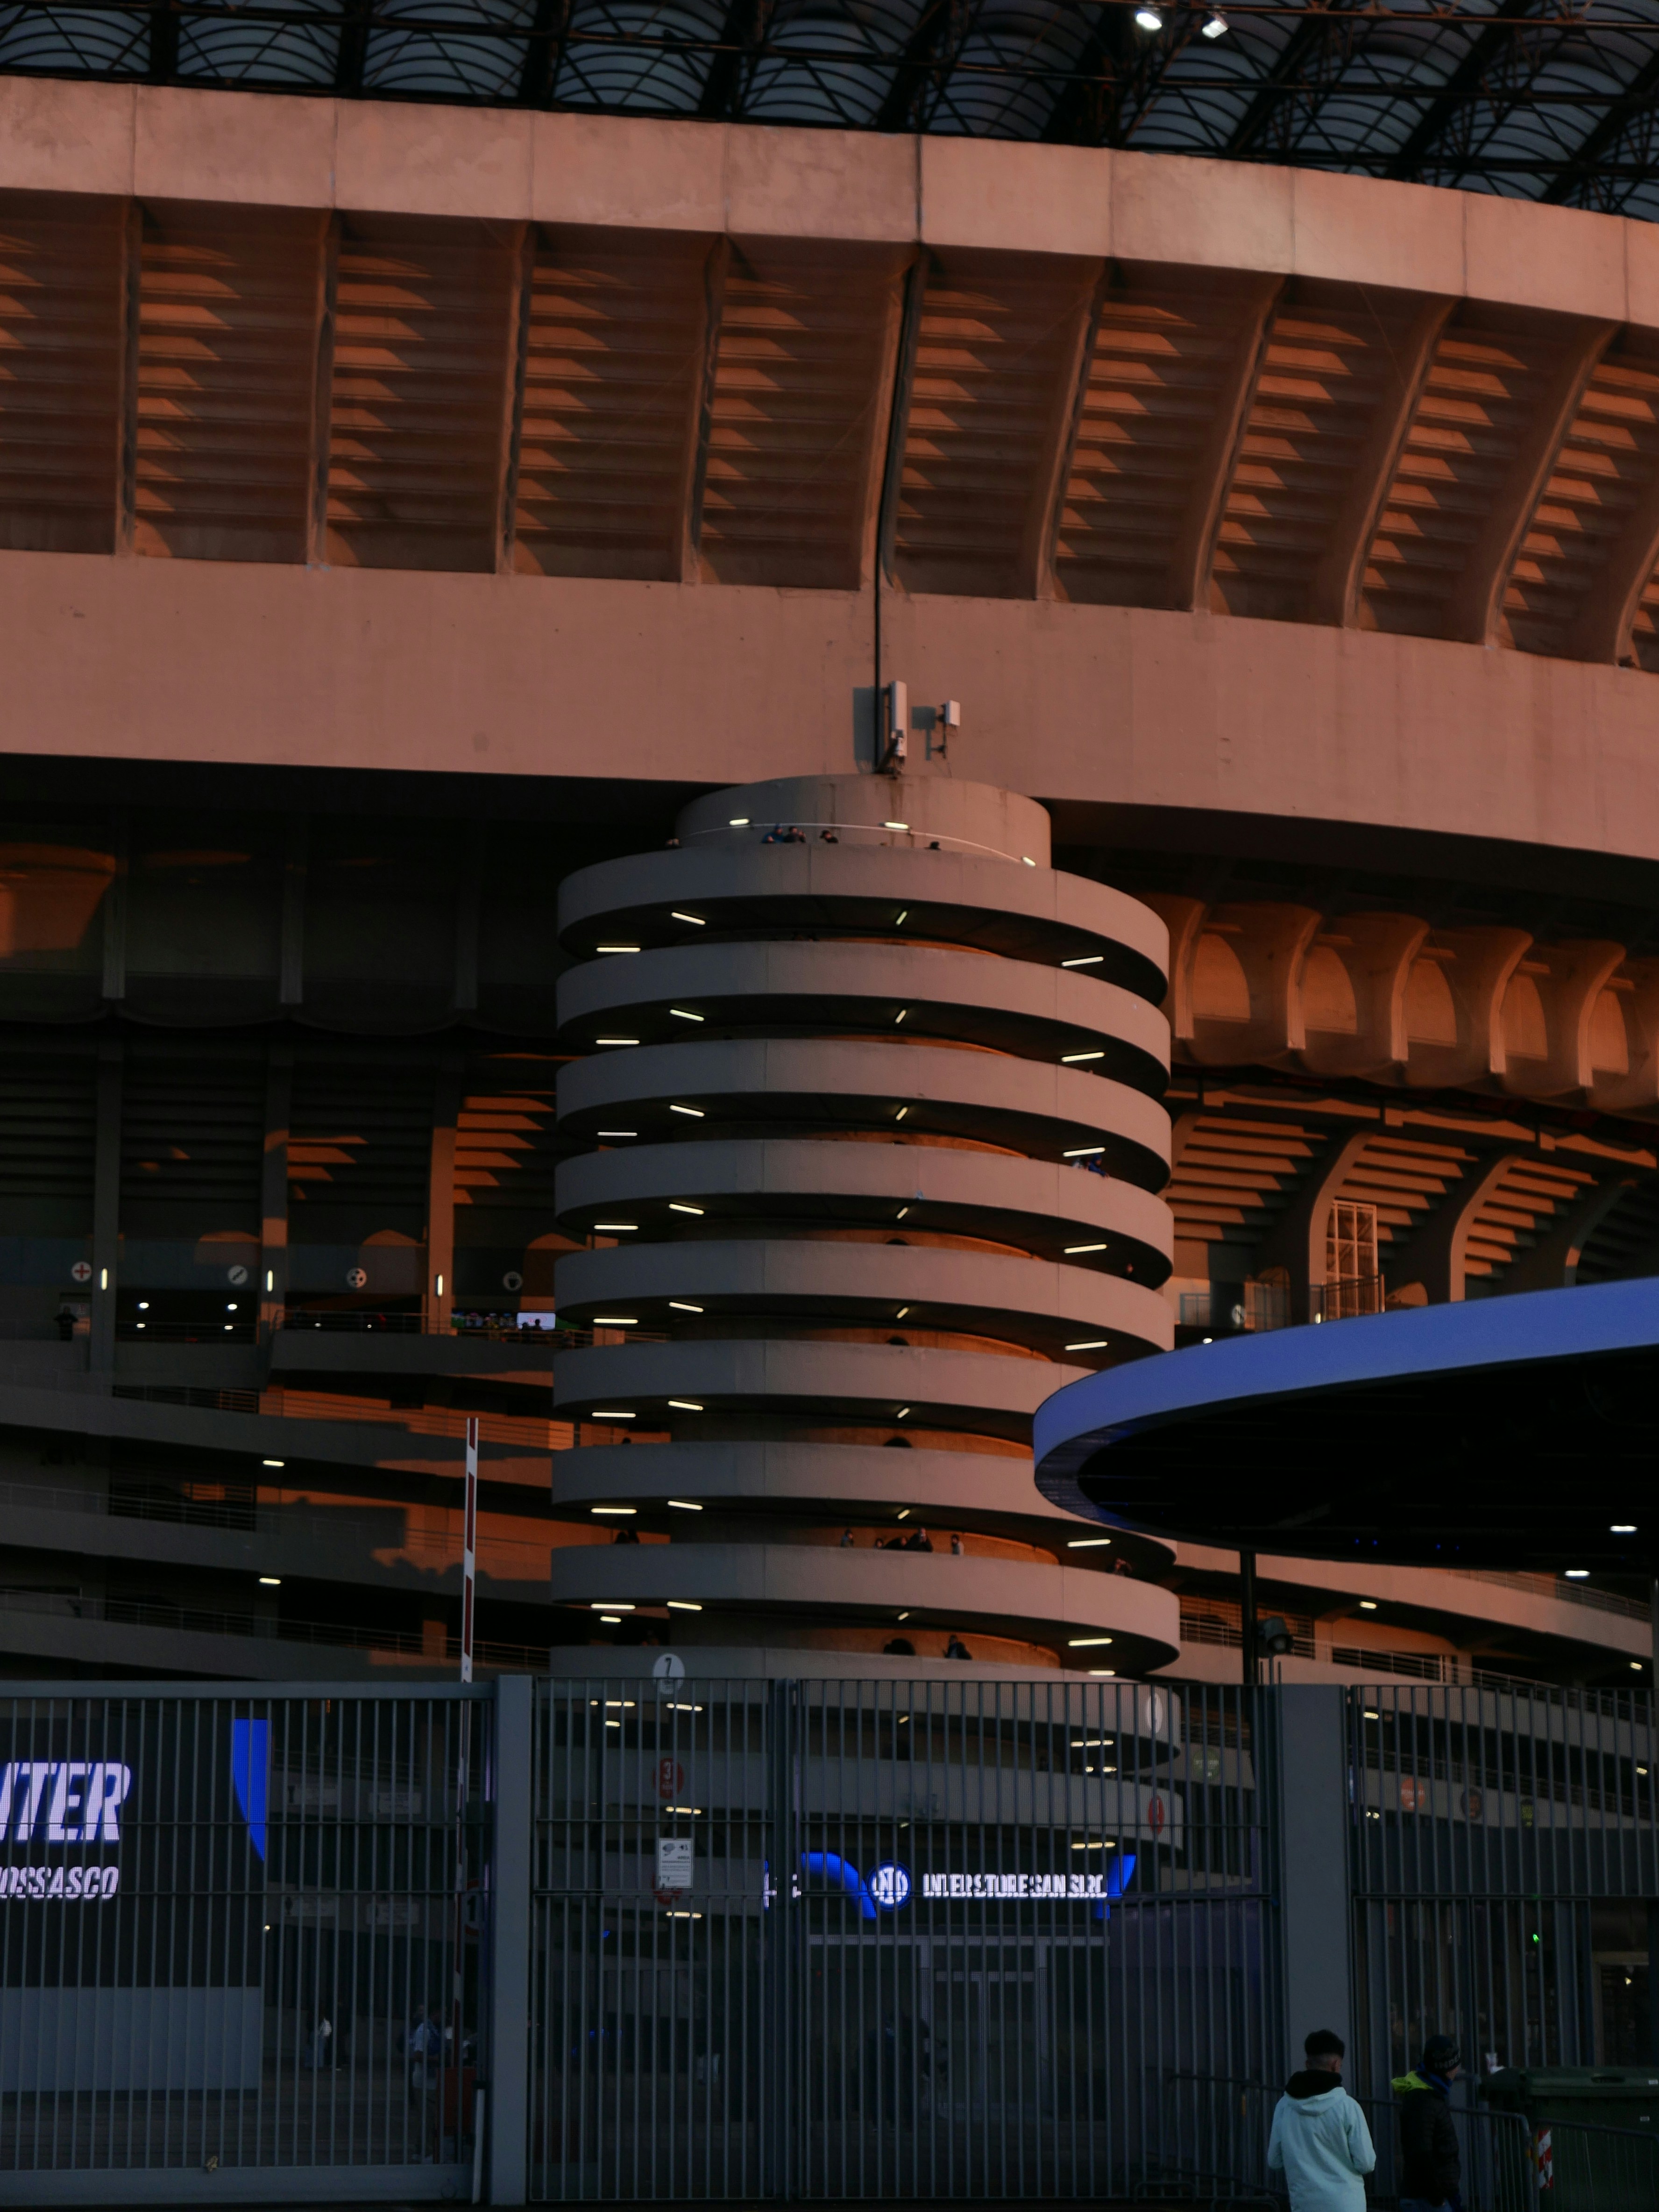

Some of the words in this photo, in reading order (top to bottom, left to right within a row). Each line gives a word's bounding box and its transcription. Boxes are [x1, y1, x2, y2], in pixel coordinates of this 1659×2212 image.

[0, 1866, 119, 1899] OSSASCO
[923, 1873, 973, 1897] INTER
[973, 1873, 1029, 1898] STORE
[1029, 1873, 1066, 1898] SAN
